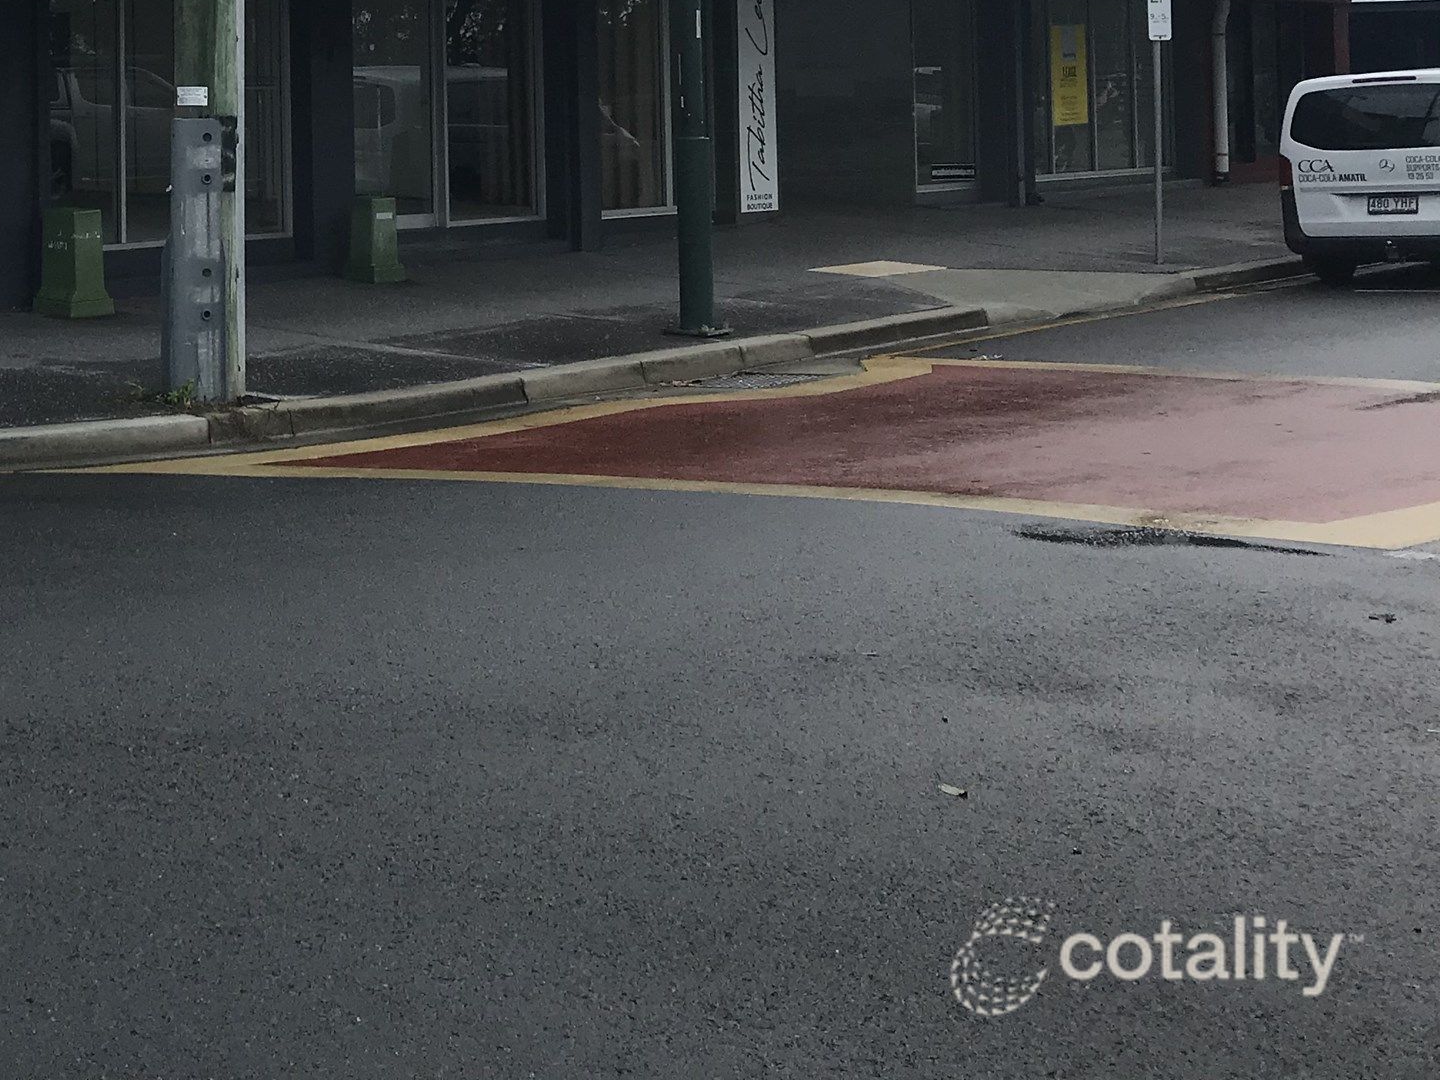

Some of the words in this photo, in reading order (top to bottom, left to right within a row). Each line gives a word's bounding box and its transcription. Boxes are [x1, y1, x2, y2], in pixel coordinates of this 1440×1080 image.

[746, 64, 771, 192] Tabitha
[1298, 159, 1334, 173] CCA
[1338, 173, 1367, 182] AMATIL
[746, 193, 773, 201] FASHION
[747, 202, 773, 211] BOUTIQUE
